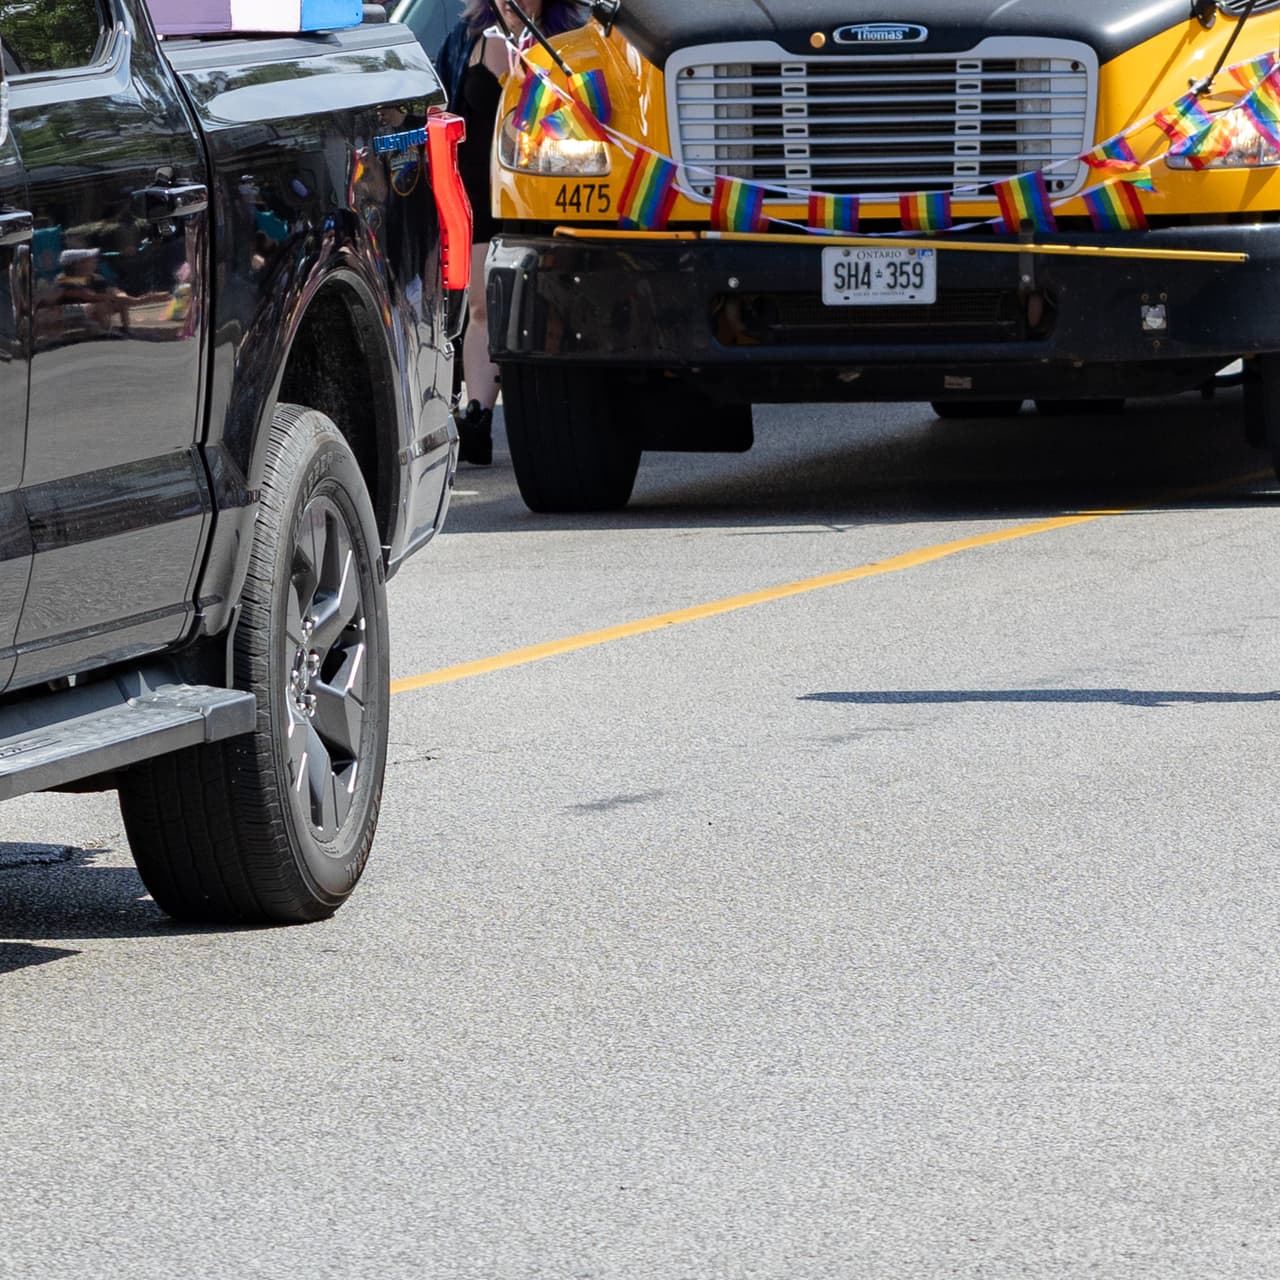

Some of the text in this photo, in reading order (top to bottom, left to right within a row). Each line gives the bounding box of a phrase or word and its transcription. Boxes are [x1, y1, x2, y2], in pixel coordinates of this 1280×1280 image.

[851, 26, 909, 40] Thomas
[555, 183, 611, 213] 4475
[856, 250, 902, 260] ONTARIO
